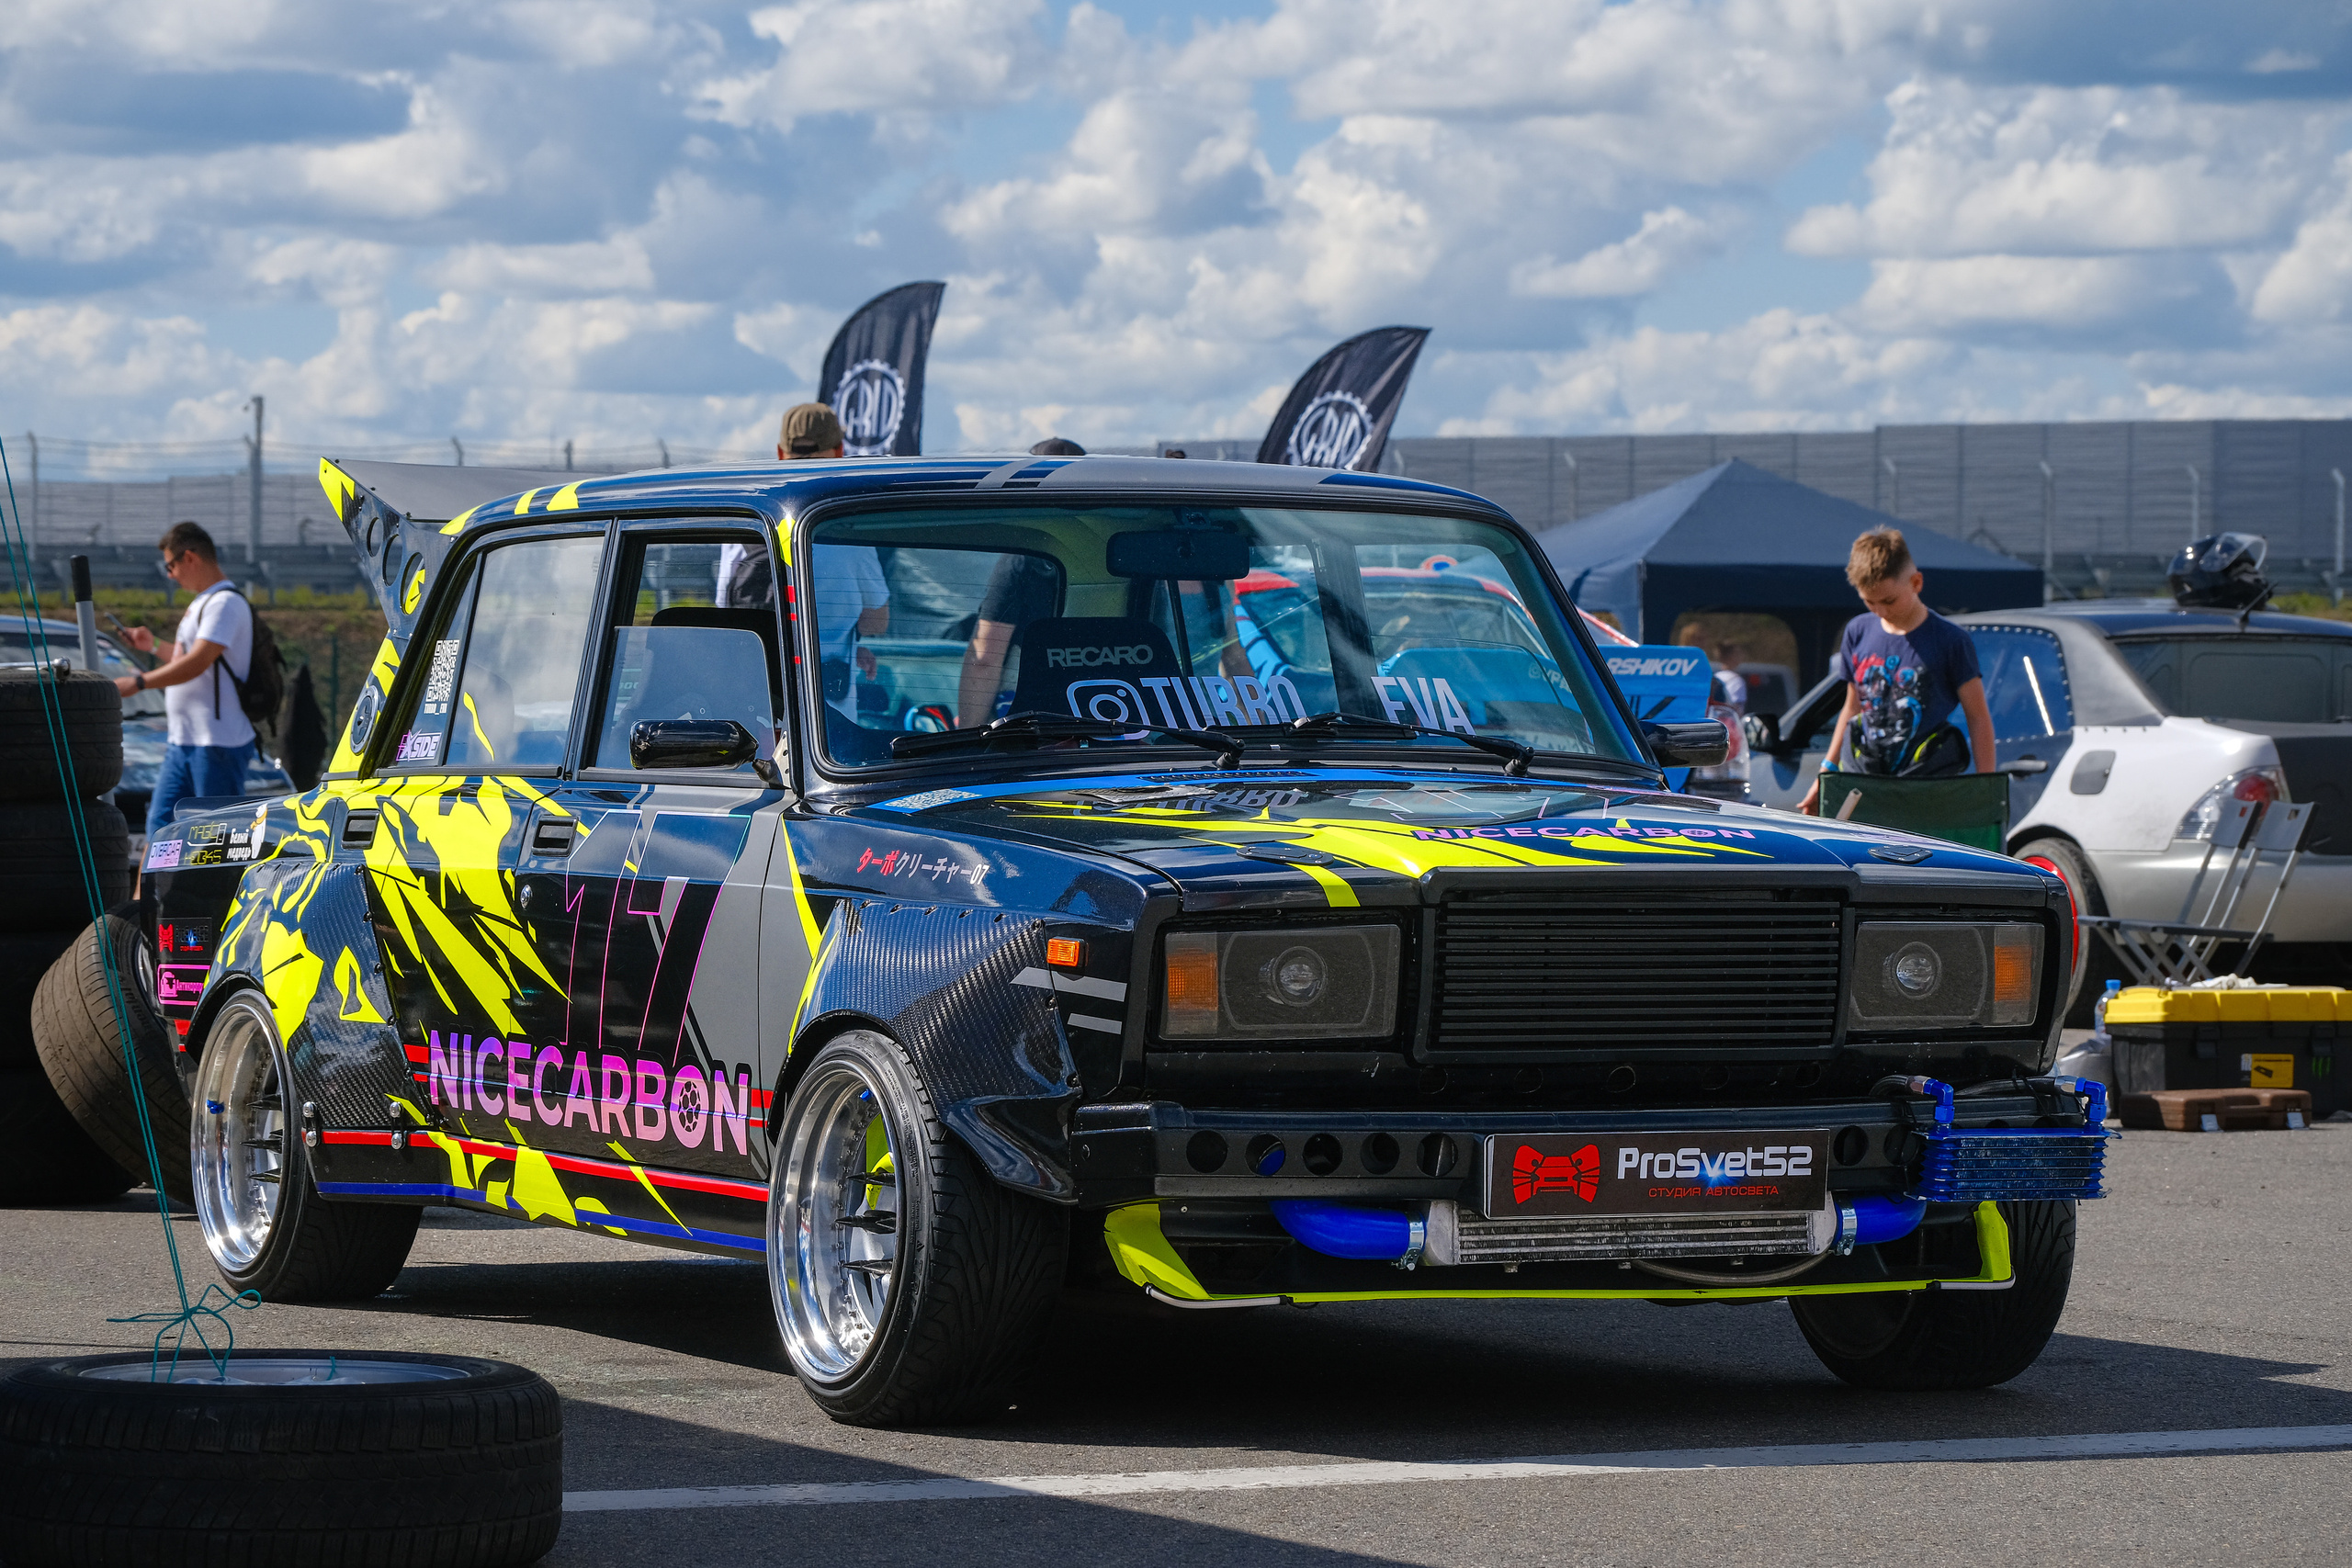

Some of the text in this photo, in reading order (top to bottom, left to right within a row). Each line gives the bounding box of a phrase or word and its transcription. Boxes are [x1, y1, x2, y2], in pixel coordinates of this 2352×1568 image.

[838, 378, 899, 440] GRID
[1300, 406, 1363, 469] GRID
[1046, 644, 1154, 668] RECARO
[1412, 826, 1756, 841] NICECARBON
[566, 809, 752, 1067] 17
[429, 1029, 749, 1156] NICECARBON
[1617, 1145, 1813, 1179] ProSvet52
[1648, 1185, 1780, 1199] СТУДИЯ АВТОСВЕТА
